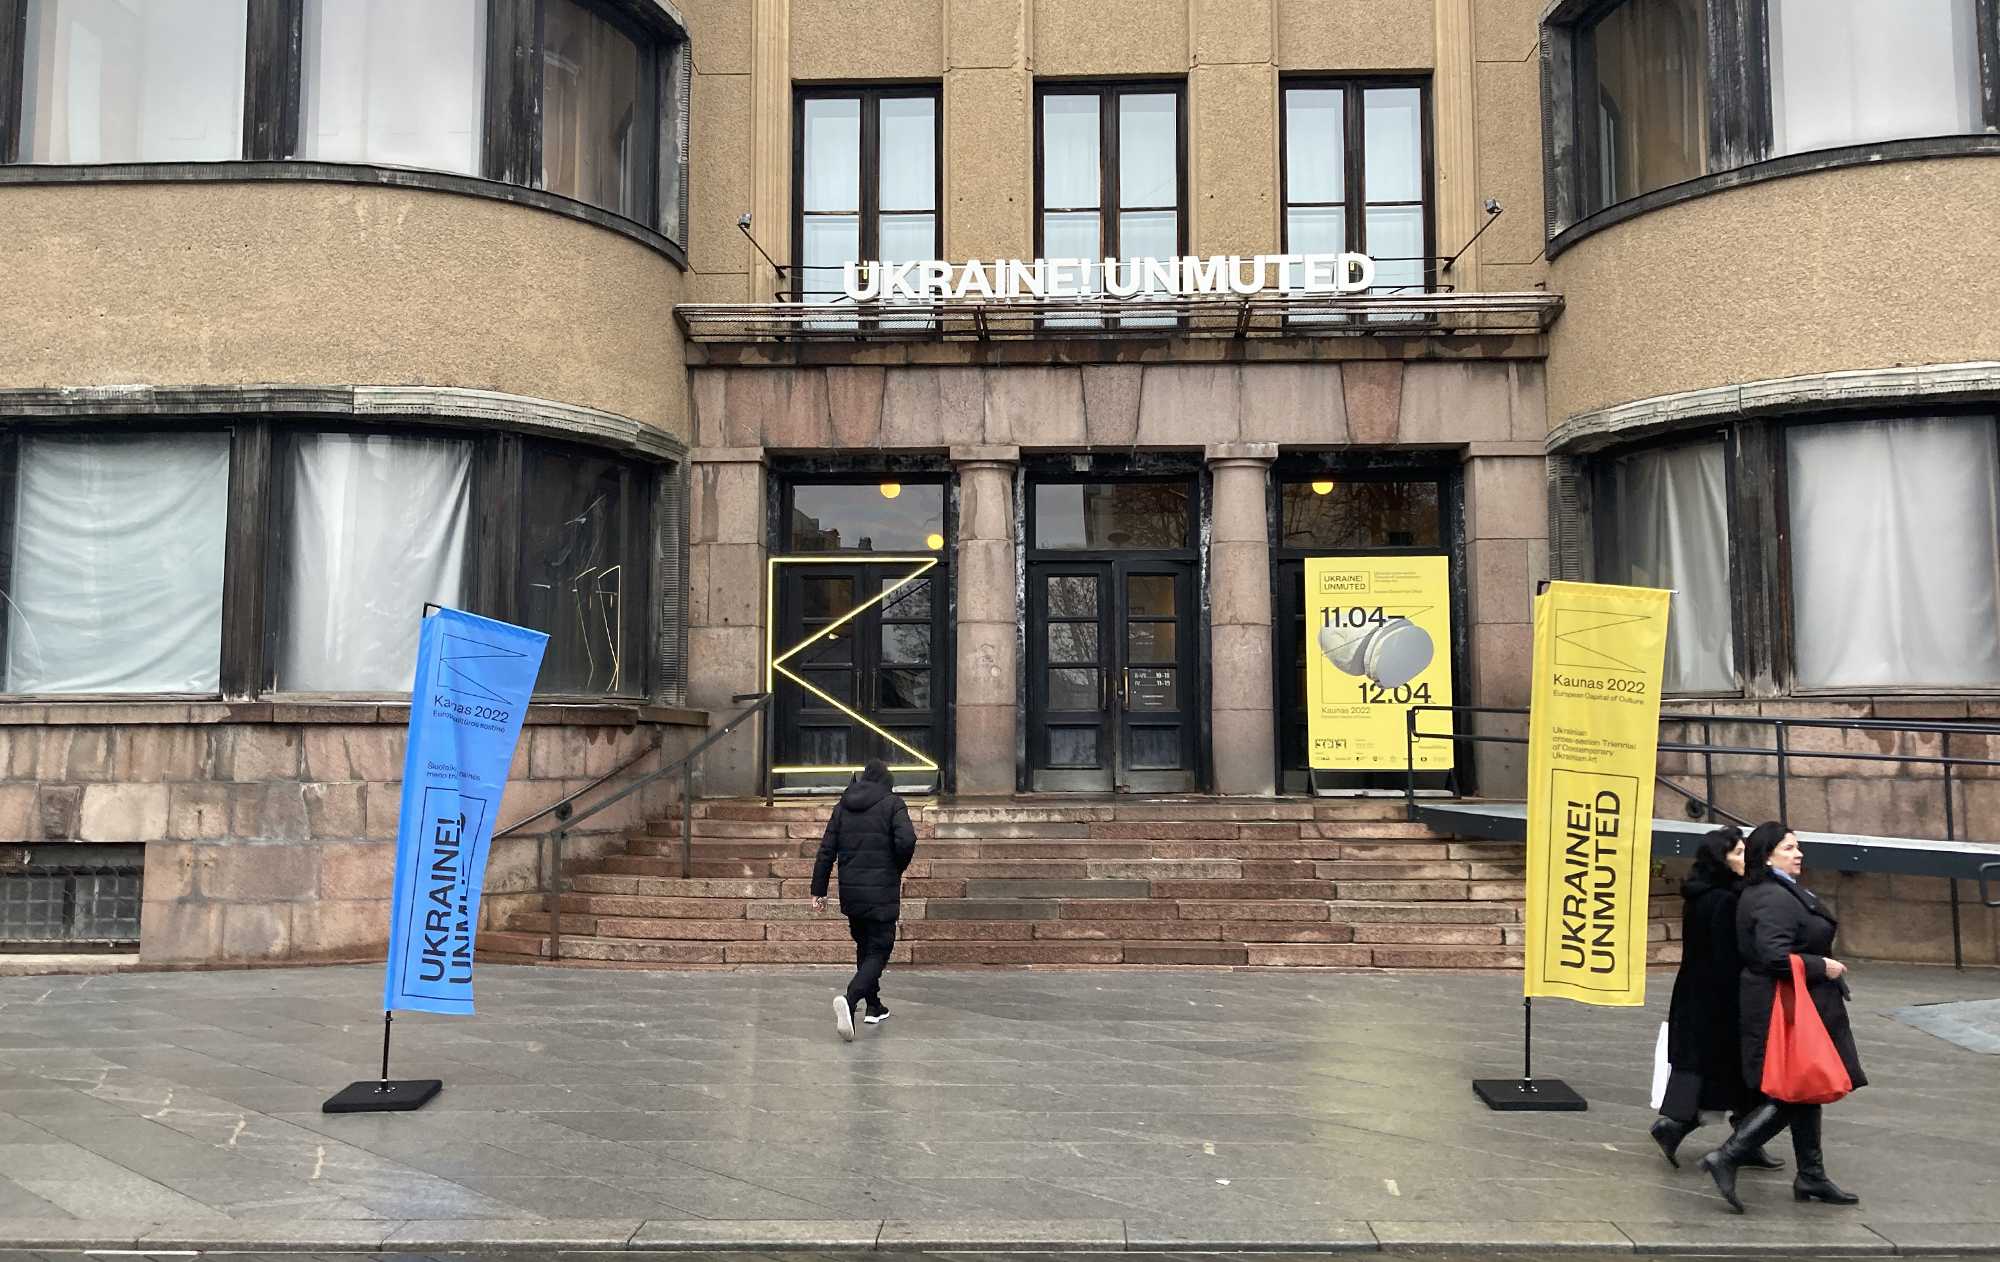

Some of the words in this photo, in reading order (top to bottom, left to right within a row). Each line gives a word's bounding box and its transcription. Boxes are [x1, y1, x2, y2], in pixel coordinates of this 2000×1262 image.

[843, 258, 1091, 303] UKRAINE!
[1105, 251, 1376, 298] UNMUTED
[1358, 682, 1431, 704] 12.04
[1553, 673, 1604, 690] Kaunas
[1607, 678, 1646, 695] 2022
[1553, 689, 1584, 699] European
[1584, 692, 1609, 702] Capital
[1618, 695, 1645, 706] Culture
[473, 705, 510, 724] 2022
[1321, 706, 1349, 714] Kaunas
[1350, 706, 1371, 714] 2022
[1552, 726, 1588, 737] Ukrainian
[1552, 737, 1600, 746] cross-section
[1602, 740, 1636, 749] Triennial
[1552, 743, 1561, 751] of
[1561, 744, 1615, 757] Contemporary
[1552, 751, 1587, 762] Ukrainian
[426, 771, 447, 779] meno
[1559, 800, 1592, 969] UKRAINE!
[1590, 790, 1621, 974] UNMUTED
[419, 818, 461, 982] UKRAINE!
